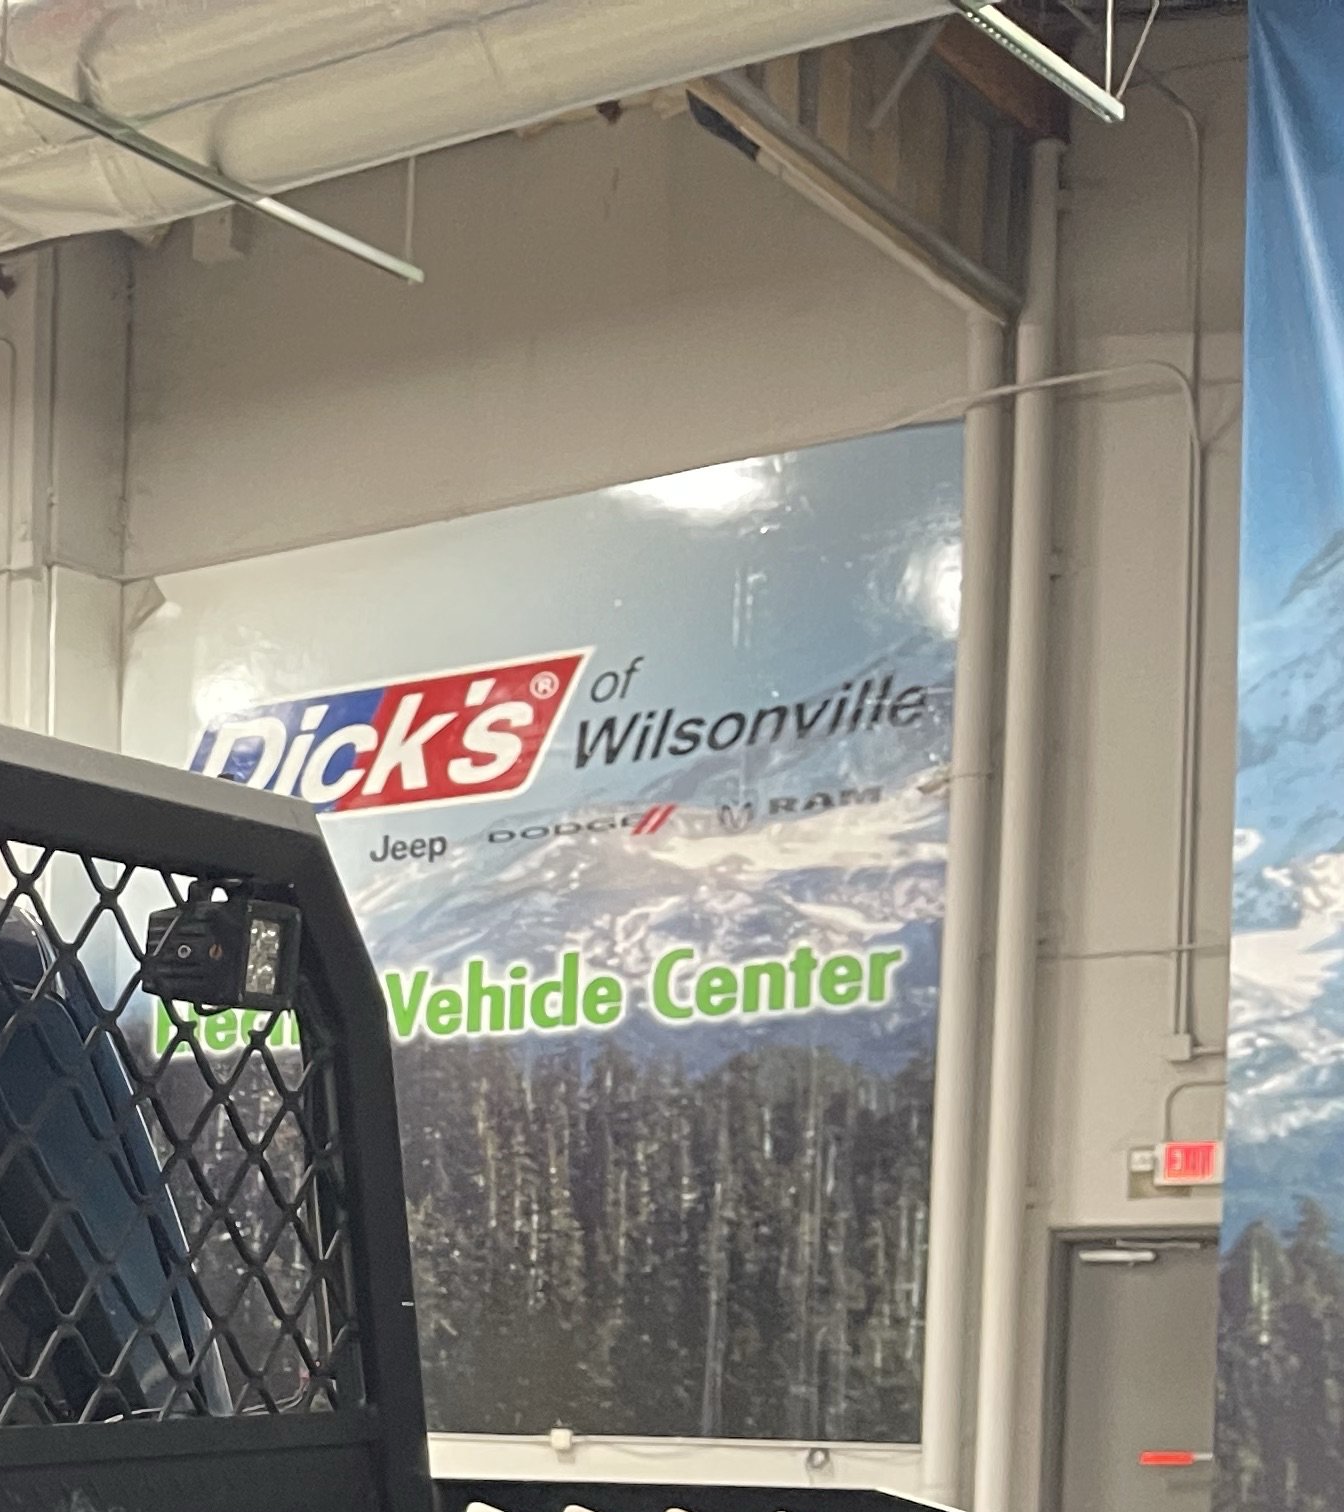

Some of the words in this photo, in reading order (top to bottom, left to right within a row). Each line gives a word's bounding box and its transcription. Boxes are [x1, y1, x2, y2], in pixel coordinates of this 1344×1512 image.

[575, 670, 929, 769] Wilsonville
[591, 656, 644, 702] of
[369, 833, 447, 864] Jeep
[767, 785, 885, 816] RAM
[385, 951, 624, 1038] Vehicle
[652, 946, 903, 1021] Center
